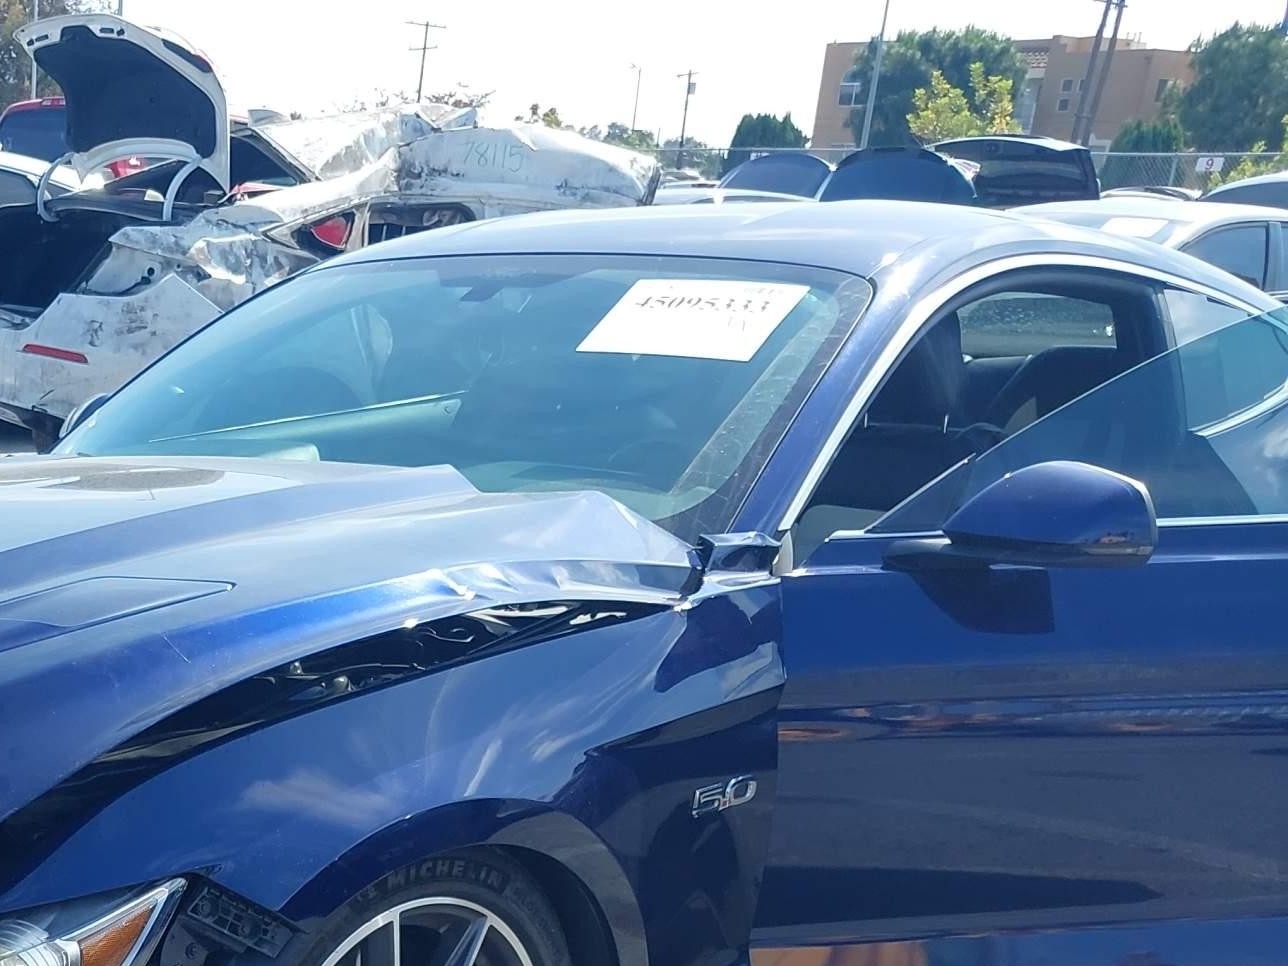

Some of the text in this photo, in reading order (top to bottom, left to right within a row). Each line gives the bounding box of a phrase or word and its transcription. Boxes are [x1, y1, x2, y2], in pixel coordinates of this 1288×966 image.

[463, 141, 523, 173] 78115
[1205, 158, 1214, 170] 9
[387, 859, 504, 889] MICHELIN
